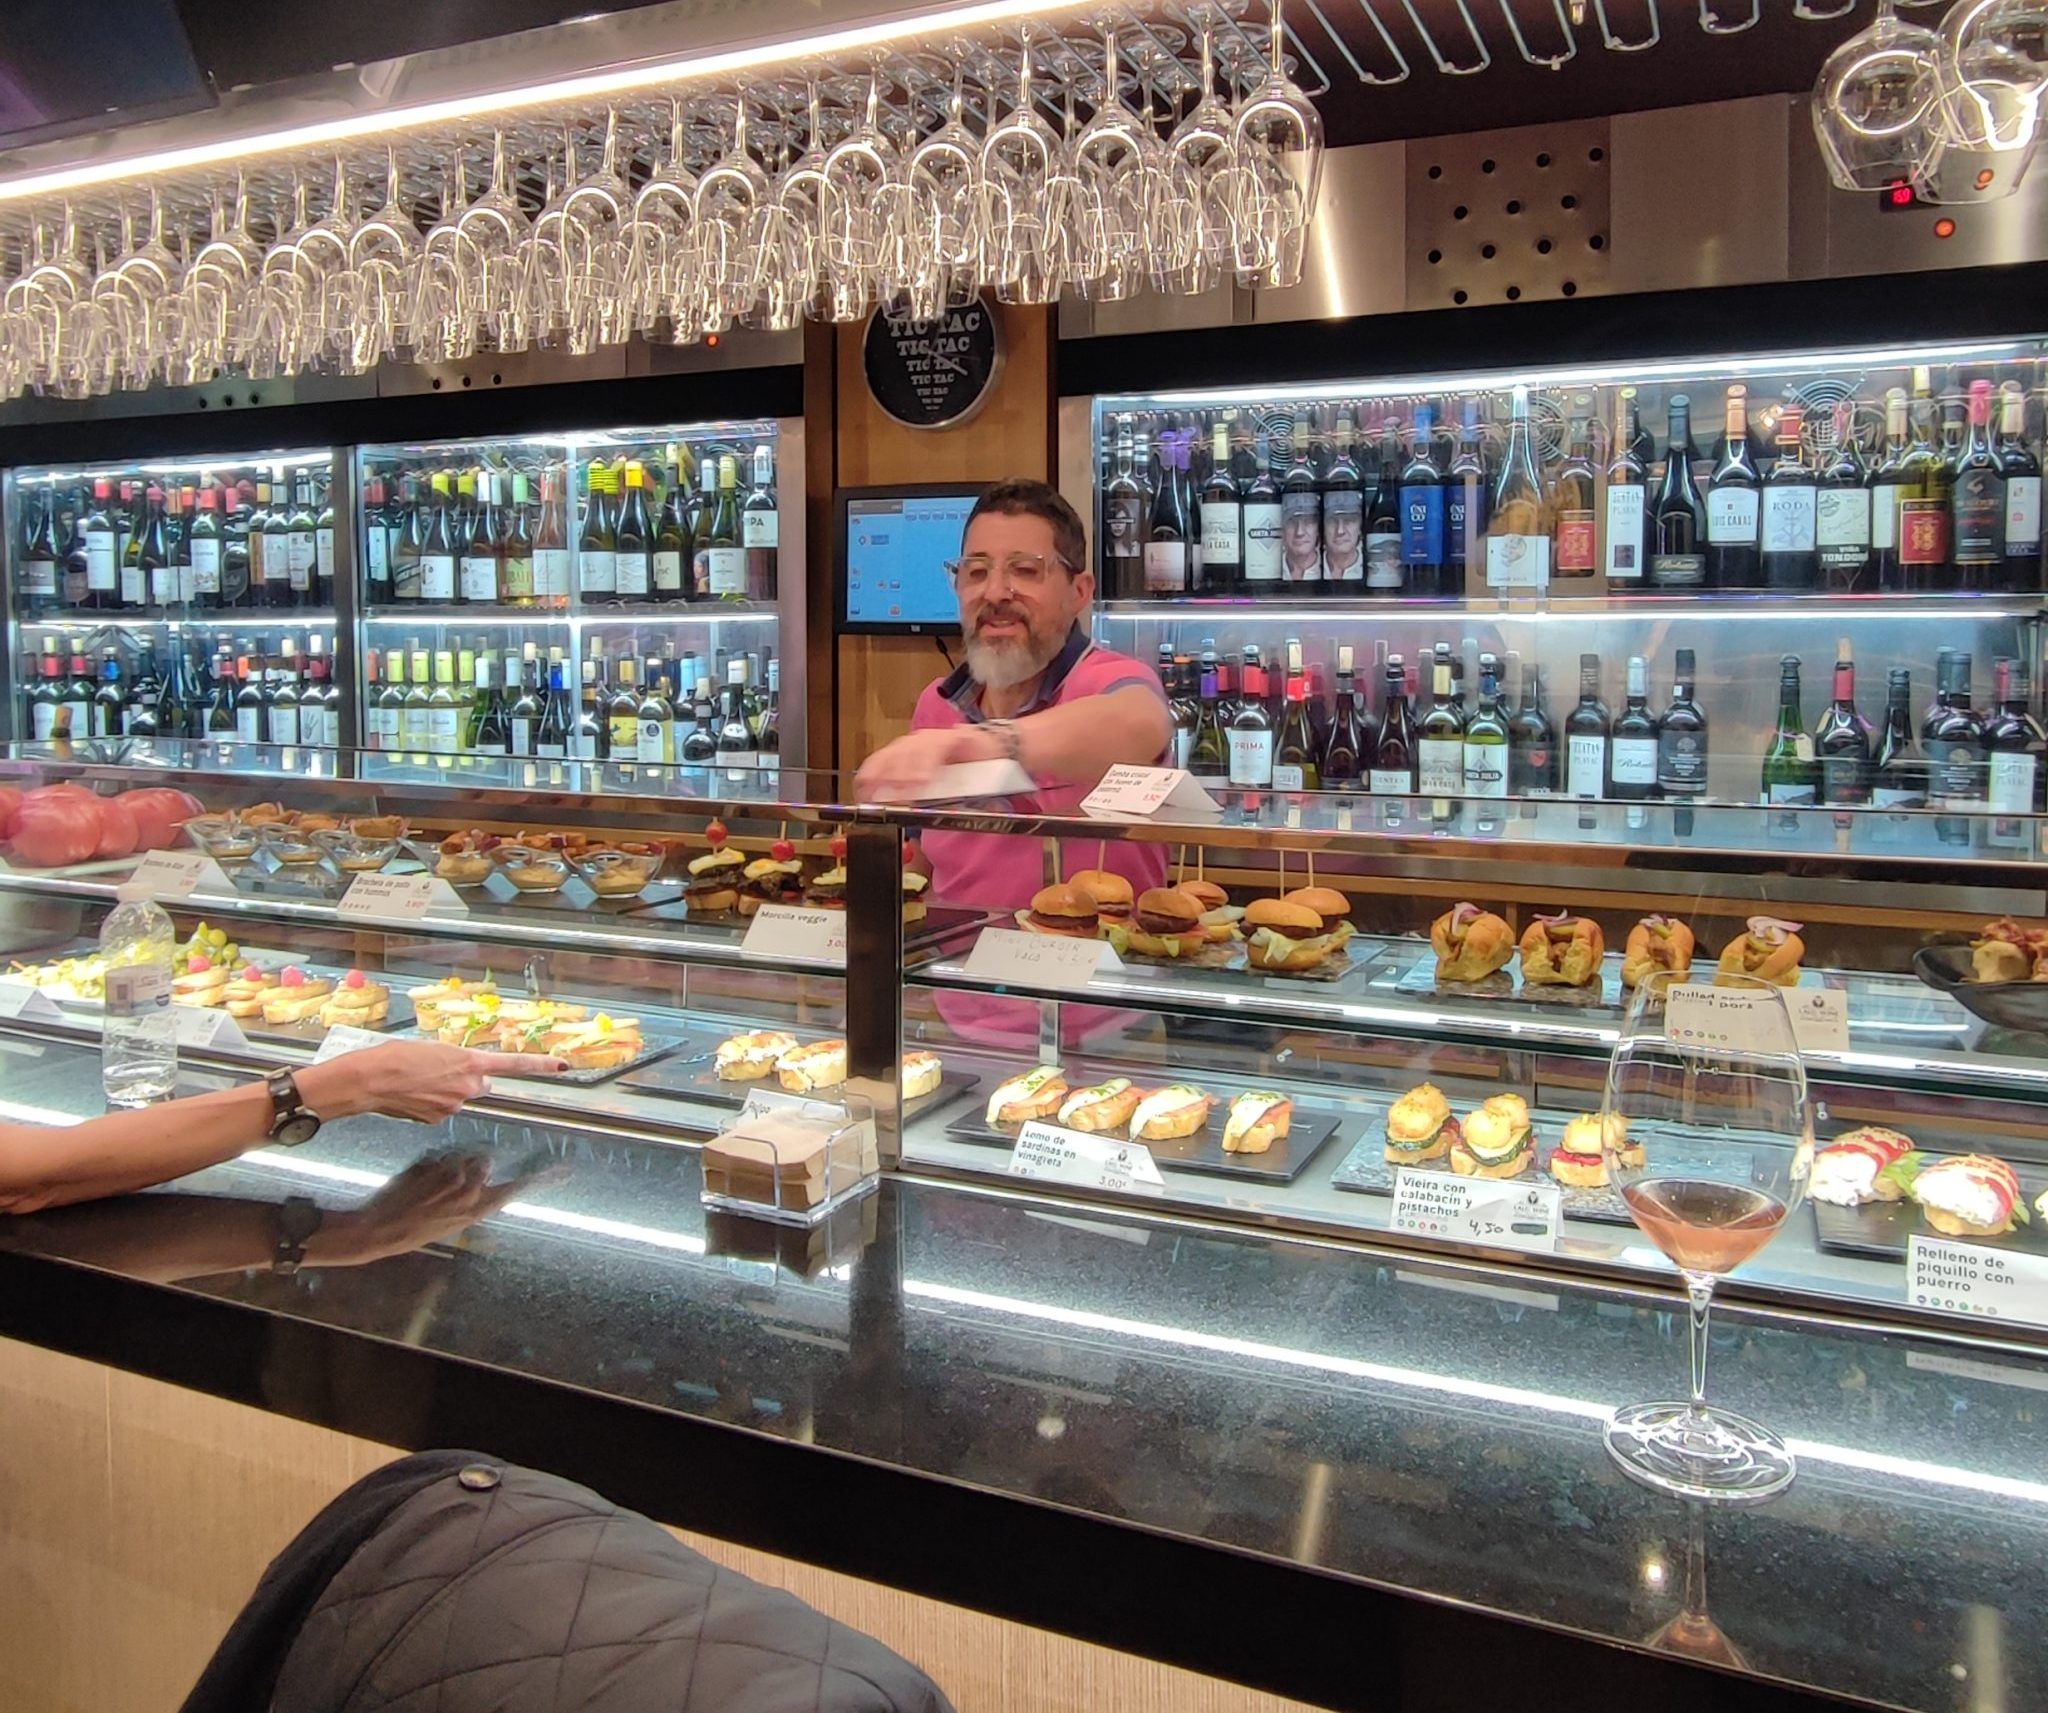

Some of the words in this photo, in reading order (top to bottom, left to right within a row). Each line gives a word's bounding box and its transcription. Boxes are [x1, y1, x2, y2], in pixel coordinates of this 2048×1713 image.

[897, 341, 930, 356] TIC
[936, 337, 971, 353] TAC
[906, 358, 930, 372] TIC
[911, 375, 931, 386] TIC
[933, 373, 955, 385] TAC
[1234, 741, 1264, 751] PRIMA
[760, 911, 795, 921] Morcilla
[797, 914, 828, 924] veggie
[1025, 1130, 1051, 1142] Lomo
[1053, 1135, 1066, 1146] de
[1021, 1140, 1061, 1156] sardinas
[1064, 1150, 1077, 1160] en
[1017, 1151, 1062, 1168] vinagreta
[1402, 1176, 1438, 1190] Vieira
[1443, 1183, 1466, 1194] con
[1400, 1190, 1461, 1206] calabacín
[1465, 1198, 1473, 1210] y
[1399, 1201, 1460, 1218] pistachos
[1469, 1219, 1504, 1236] 4,50
[1917, 1246, 1978, 1265] Relleno
[1984, 1257, 2005, 1269] de
[1916, 1261, 1978, 1280] piquillo
[1984, 1272, 2015, 1286] con
[1916, 1275, 1971, 1293] puerro
